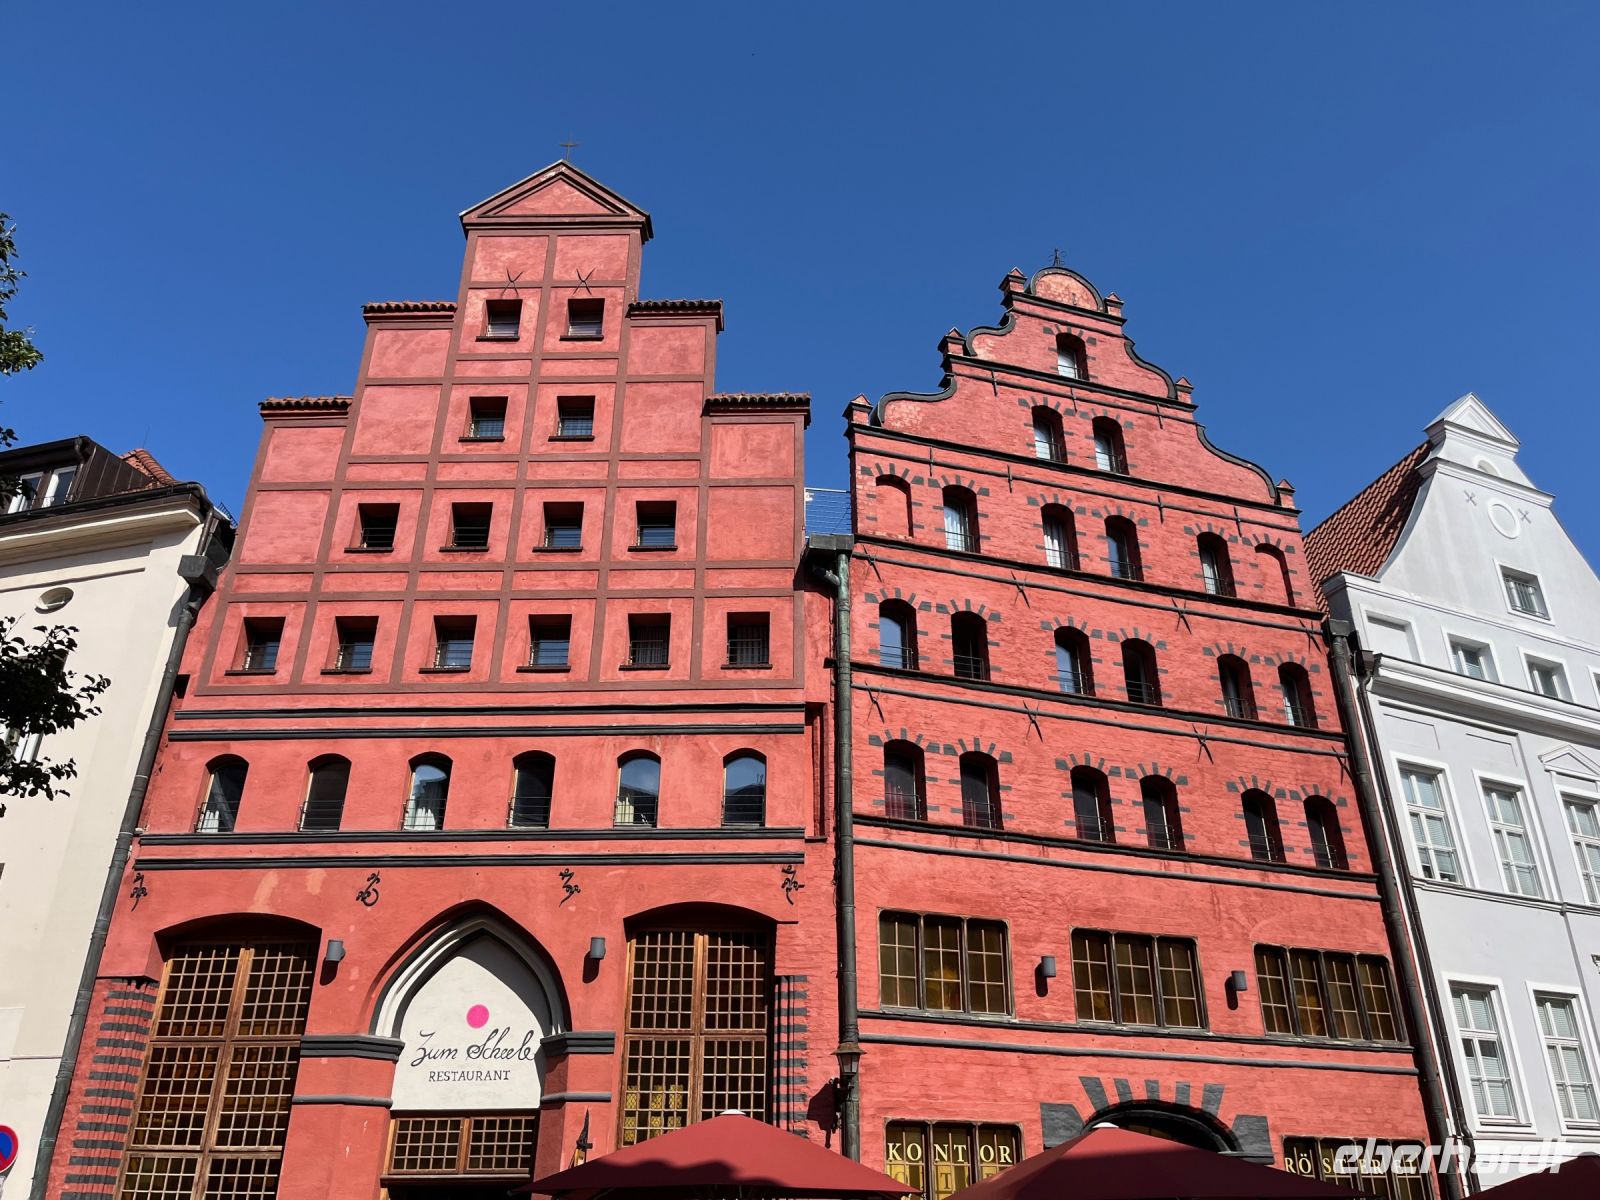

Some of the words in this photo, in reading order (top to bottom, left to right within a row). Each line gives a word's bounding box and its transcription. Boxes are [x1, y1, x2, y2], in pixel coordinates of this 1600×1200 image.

[411, 1029, 458, 1066] Zum
[466, 1026, 536, 1061] Scheele
[429, 1070, 511, 1082] RESTAURANT
[887, 1142, 1013, 1163] KONTOR
